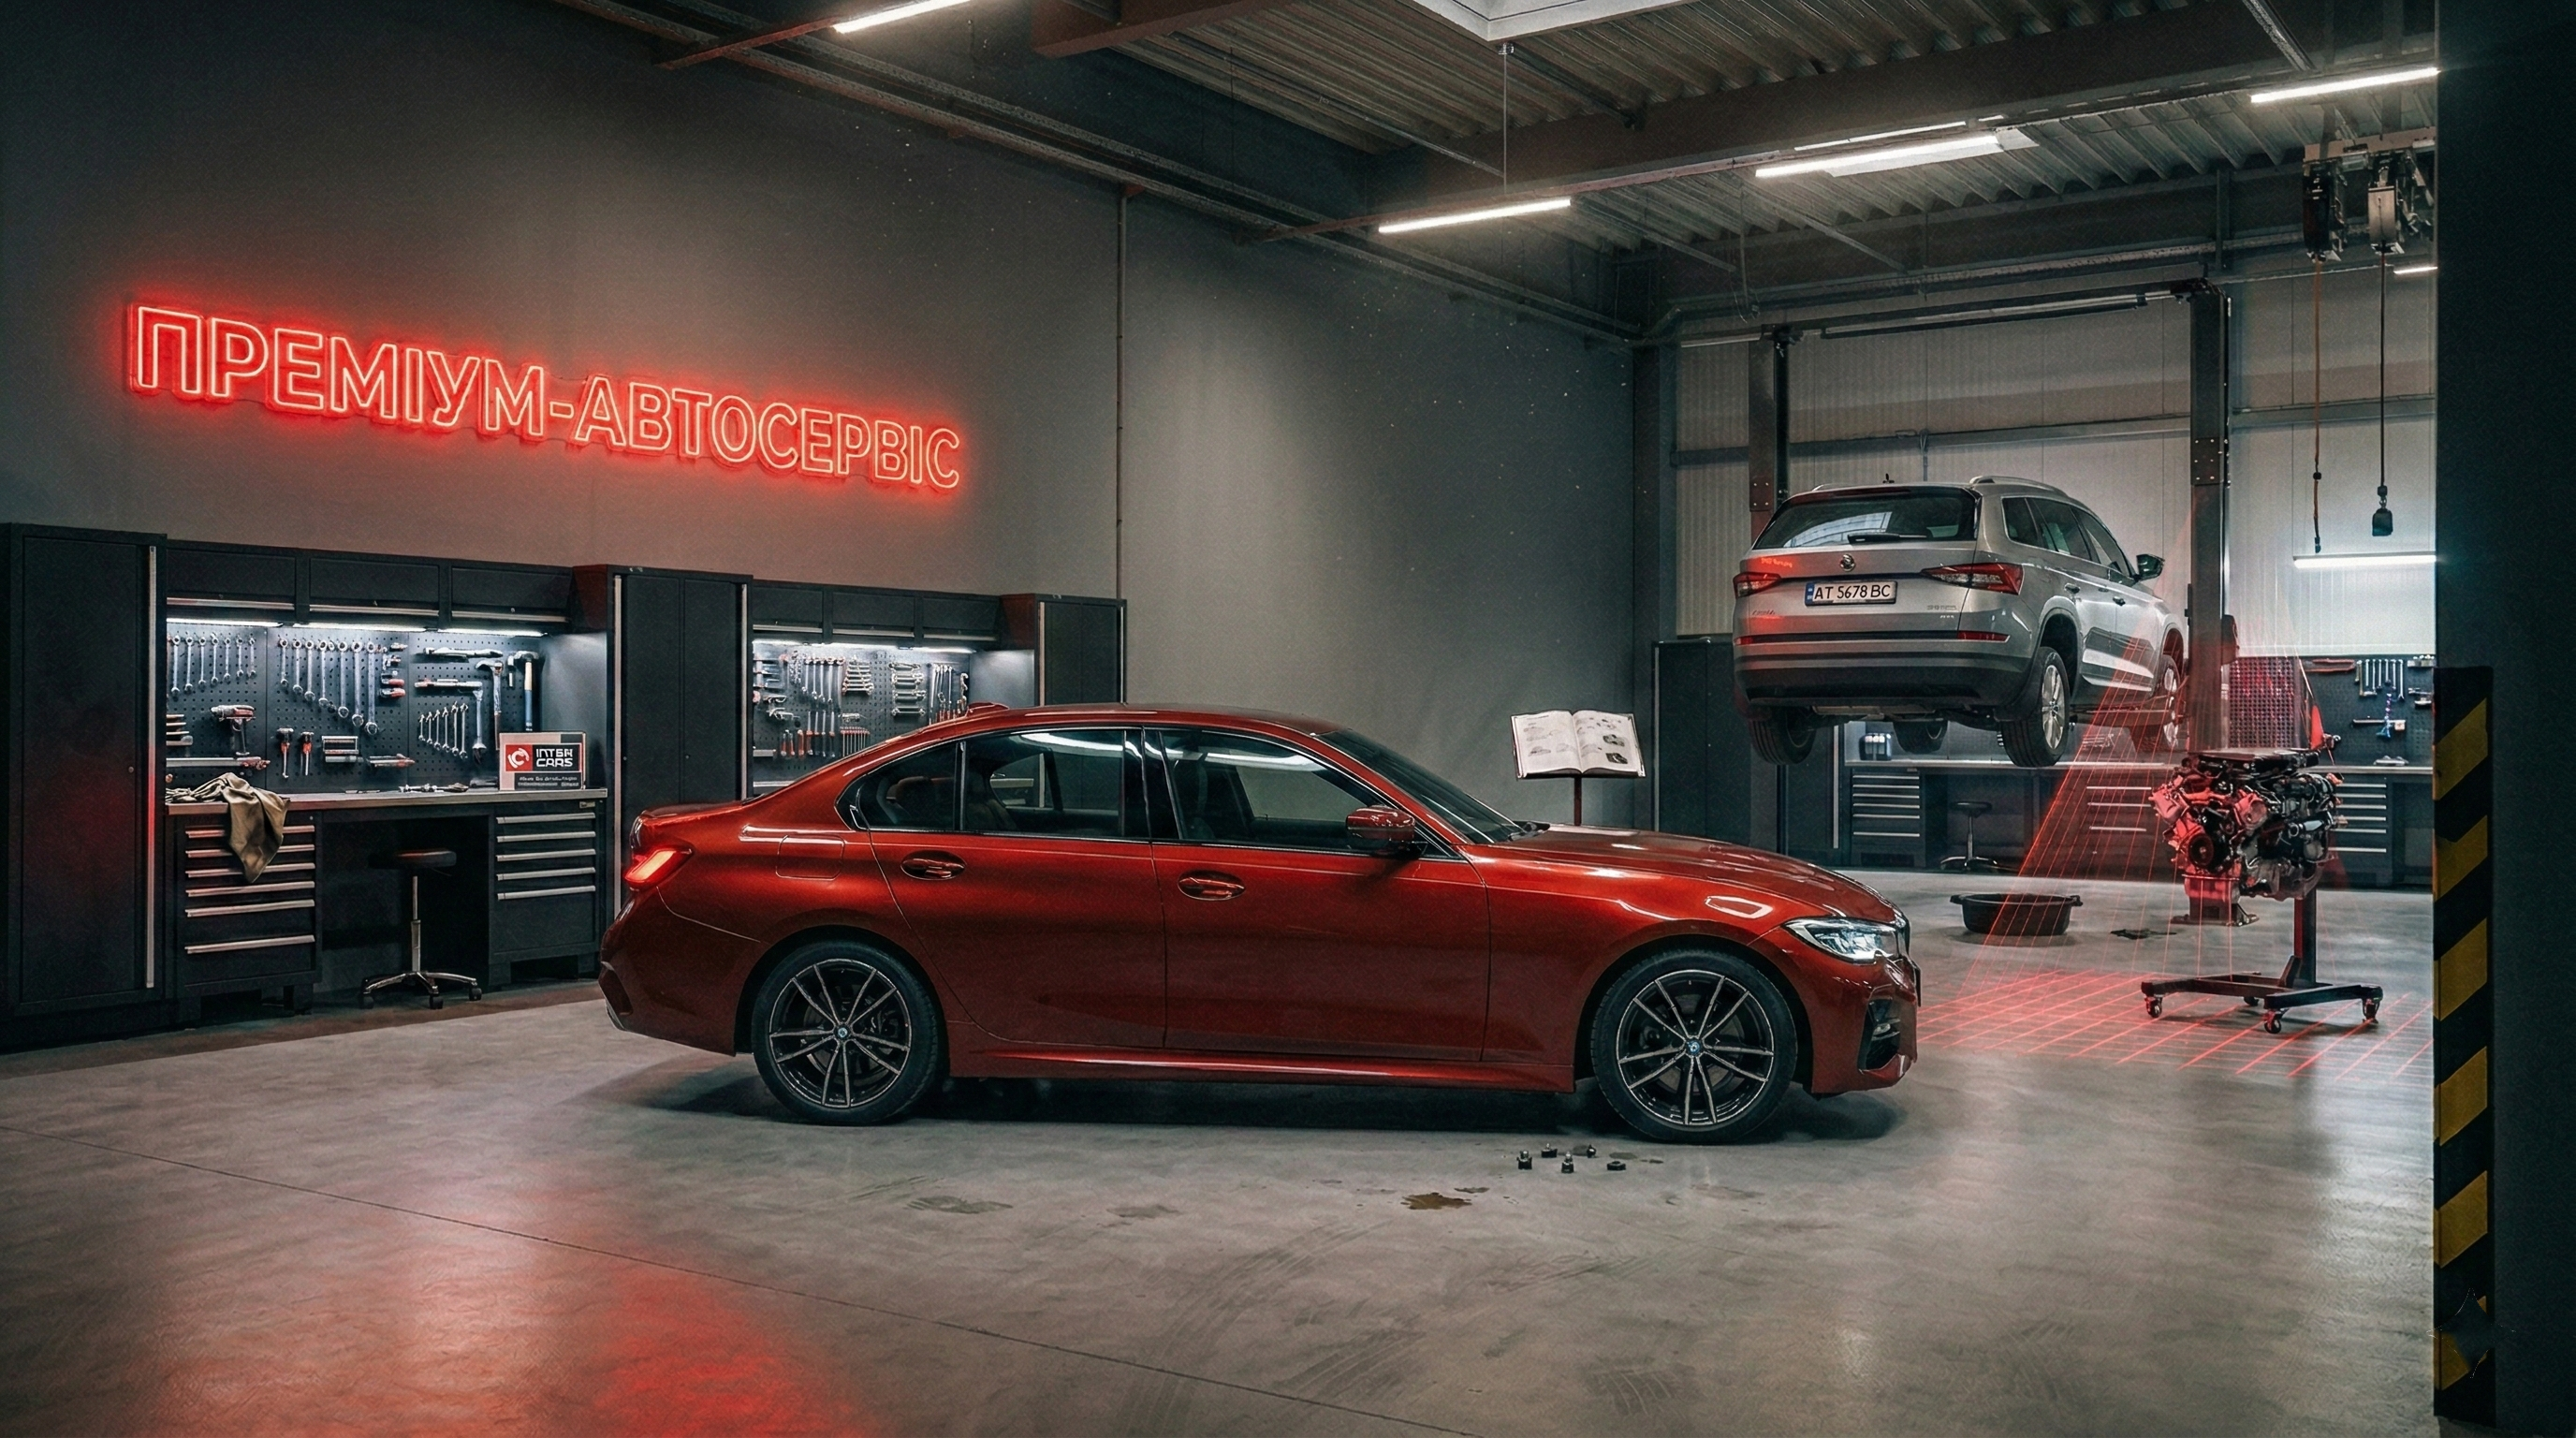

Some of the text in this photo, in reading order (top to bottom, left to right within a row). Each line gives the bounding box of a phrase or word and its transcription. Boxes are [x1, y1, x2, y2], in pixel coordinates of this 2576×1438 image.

[134, 304, 961, 490] ПРЕМІУМ-АВТОСЕРВІС
[1814, 586, 1834, 600] AT
[1837, 585, 1868, 599] 5678
[1870, 584, 1891, 598] BC
[535, 757, 574, 768] CARS
